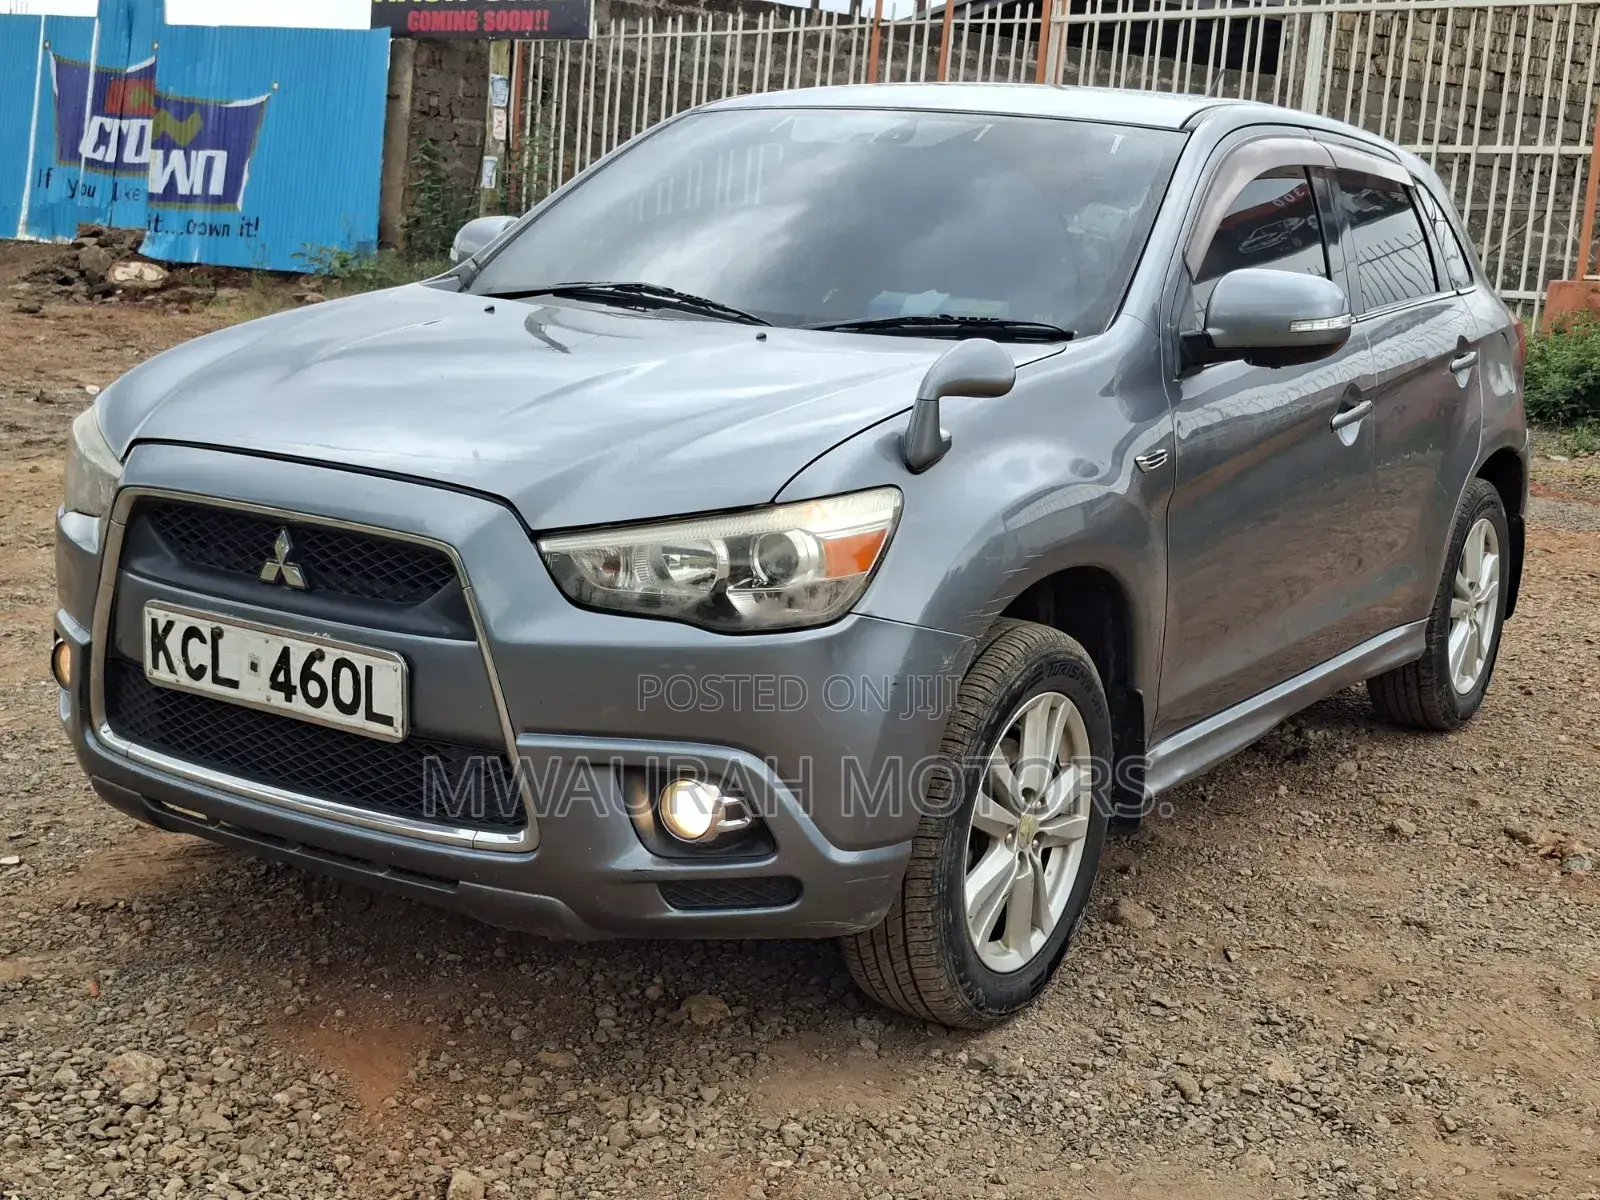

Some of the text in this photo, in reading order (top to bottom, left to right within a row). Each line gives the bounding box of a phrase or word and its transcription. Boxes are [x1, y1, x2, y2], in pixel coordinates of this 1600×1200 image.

[407, 10, 551, 32] COMING SOON!!
[38, 168, 141, 201] If you lke
[239, 216, 260, 238] it!
[151, 617, 395, 728] KCL 460L
